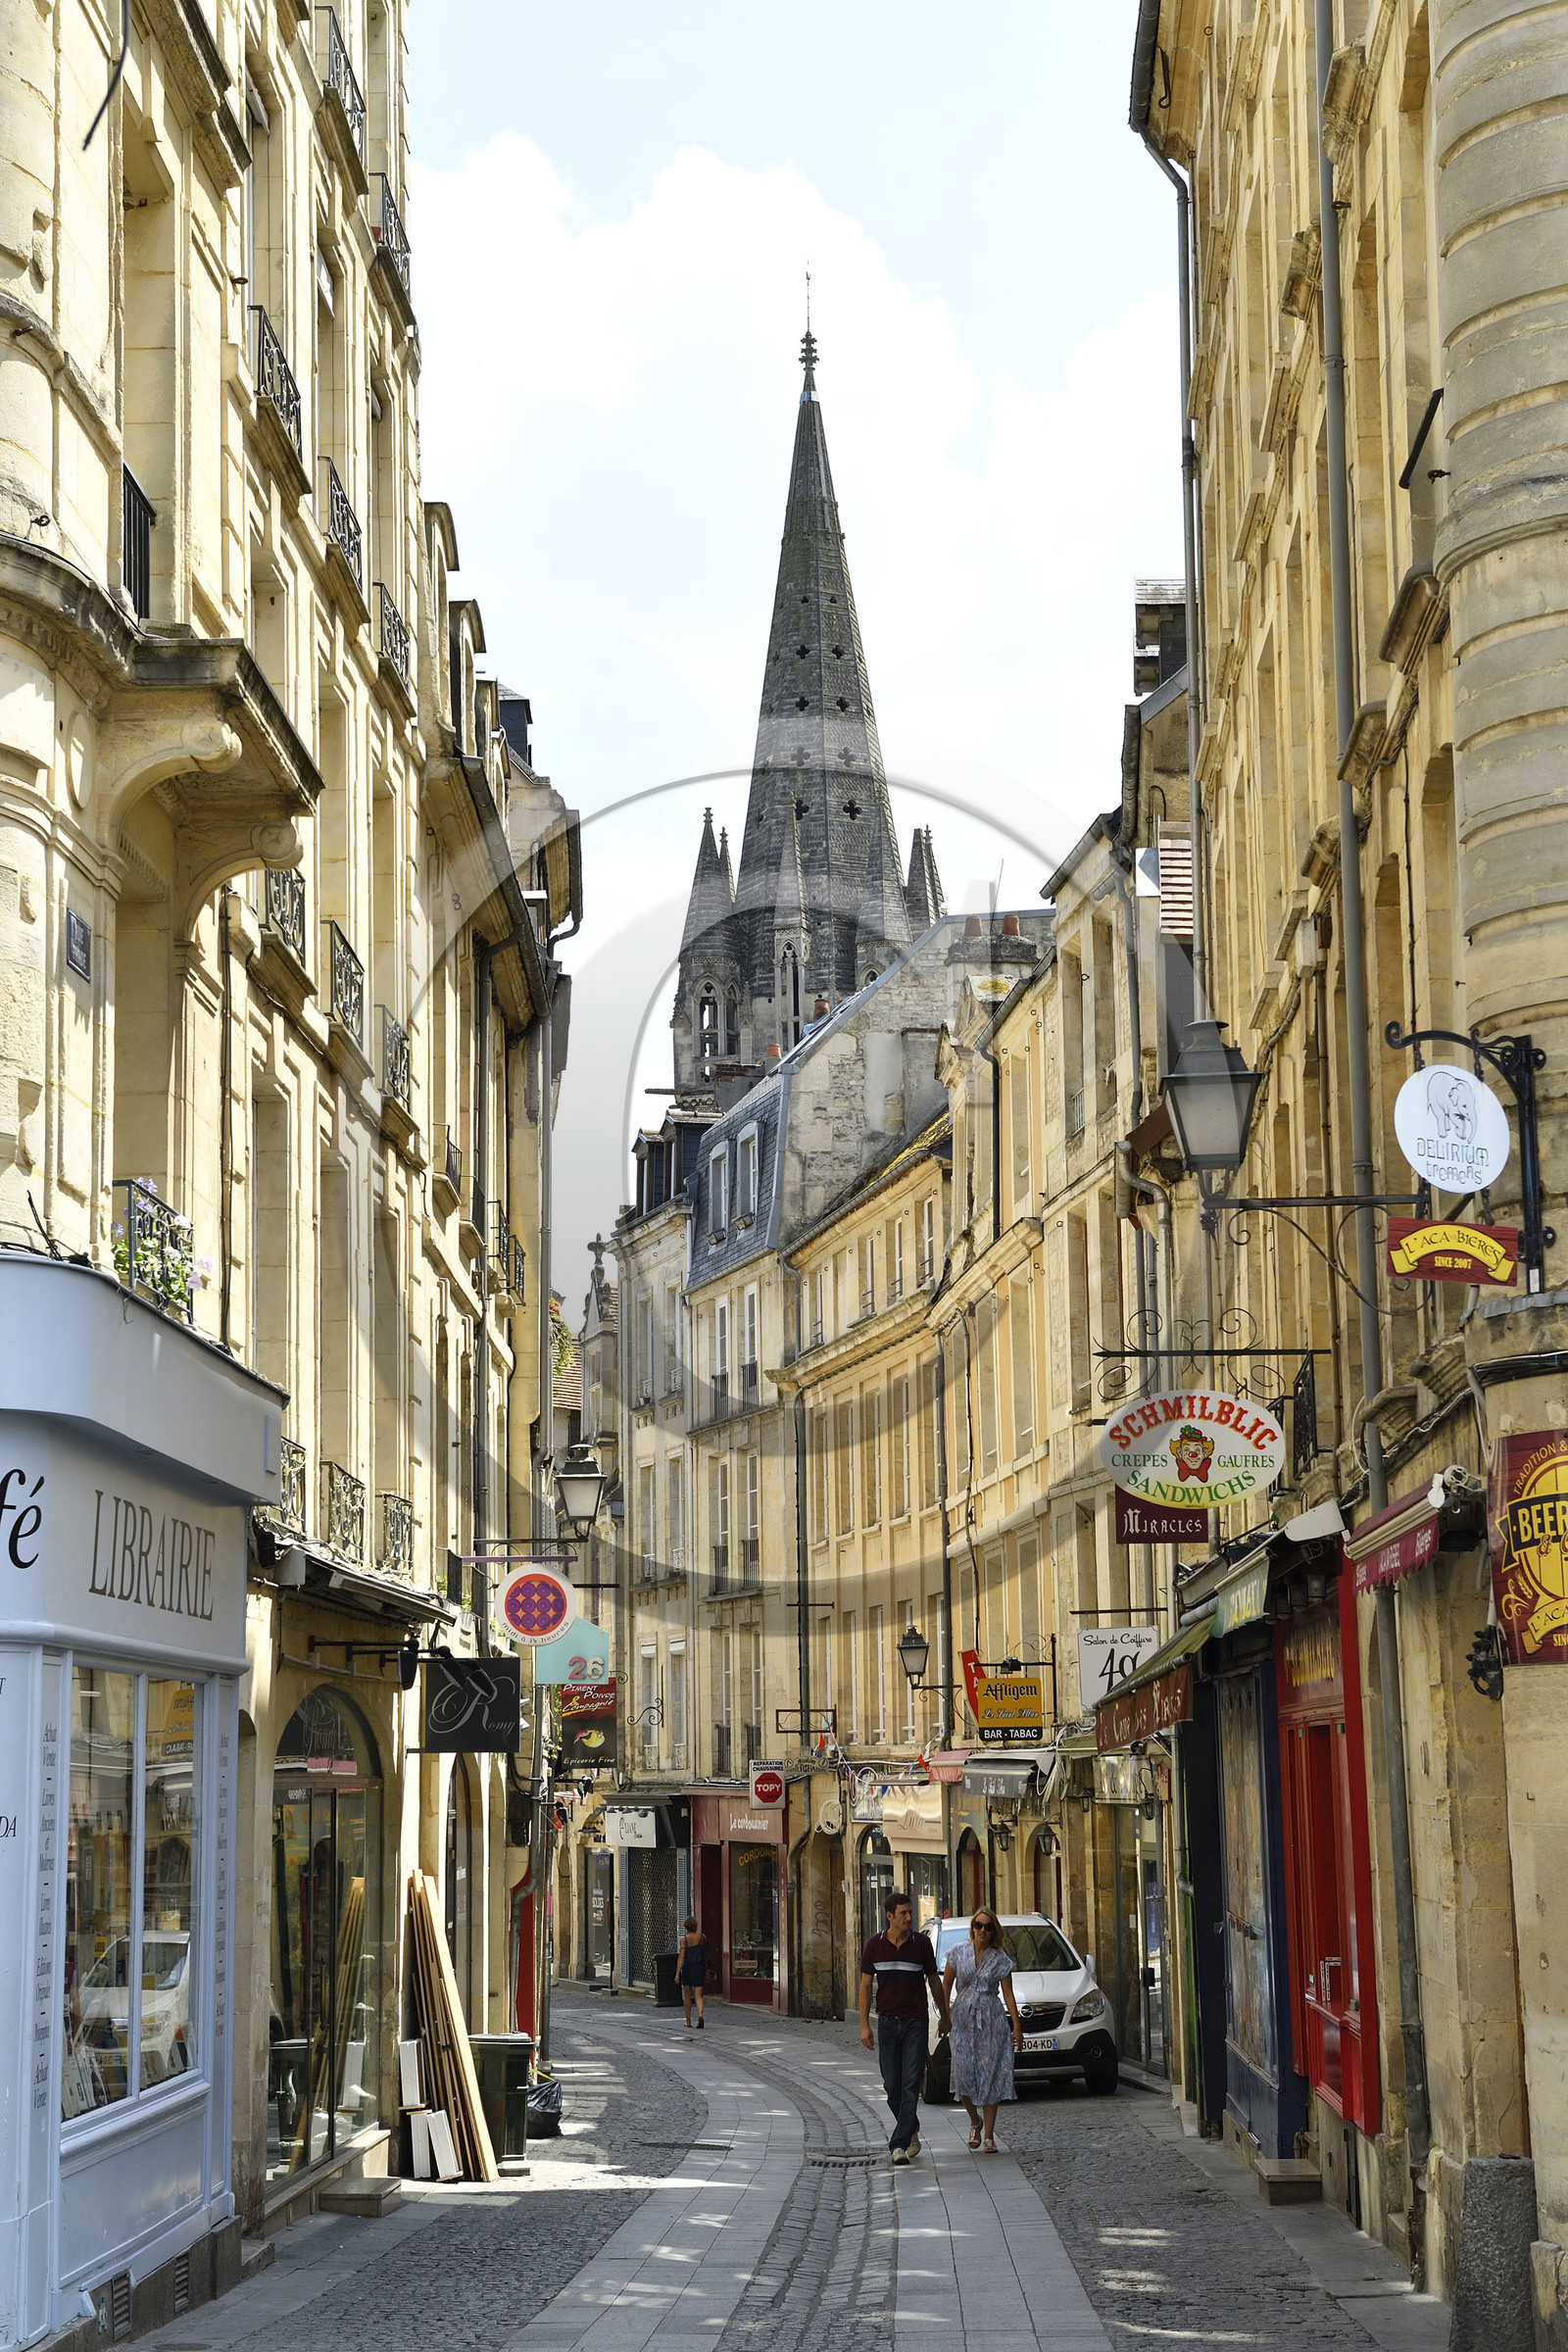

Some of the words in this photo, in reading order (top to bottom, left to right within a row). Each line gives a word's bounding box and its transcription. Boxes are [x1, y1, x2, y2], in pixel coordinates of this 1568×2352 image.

[1416, 1137, 1490, 1167] DELIRIUM
[1434, 1255, 1453, 1267] SINCE
[1454, 1257, 1472, 1269] 2007
[1108, 1395, 1279, 1451] SCHMILBLIC
[1111, 1453, 1168, 1468] CREPES
[1217, 1454, 1275, 1468] GAUFRES
[1513, 1442, 1557, 1495] TRADITION
[1126, 1470, 1256, 1504] SANDWICHS
[88, 1489, 216, 1622] LIBRAIRIE
[502, 1622, 519, 1639] midi
[541, 1621, 569, 1642] heures
[1083, 1635, 1107, 1645] Salon
[1110, 1635, 1118, 1644] de
[1120, 1633, 1152, 1647] Coiffure
[568, 1655, 605, 1681] 26
[982, 1683, 1037, 1701] Affligem
[562, 1699, 614, 1712] Compagnie
[984, 1730, 1003, 1739] BAR
[1008, 1729, 1038, 1739] TABAC
[756, 1784, 781, 1792] TOPY
